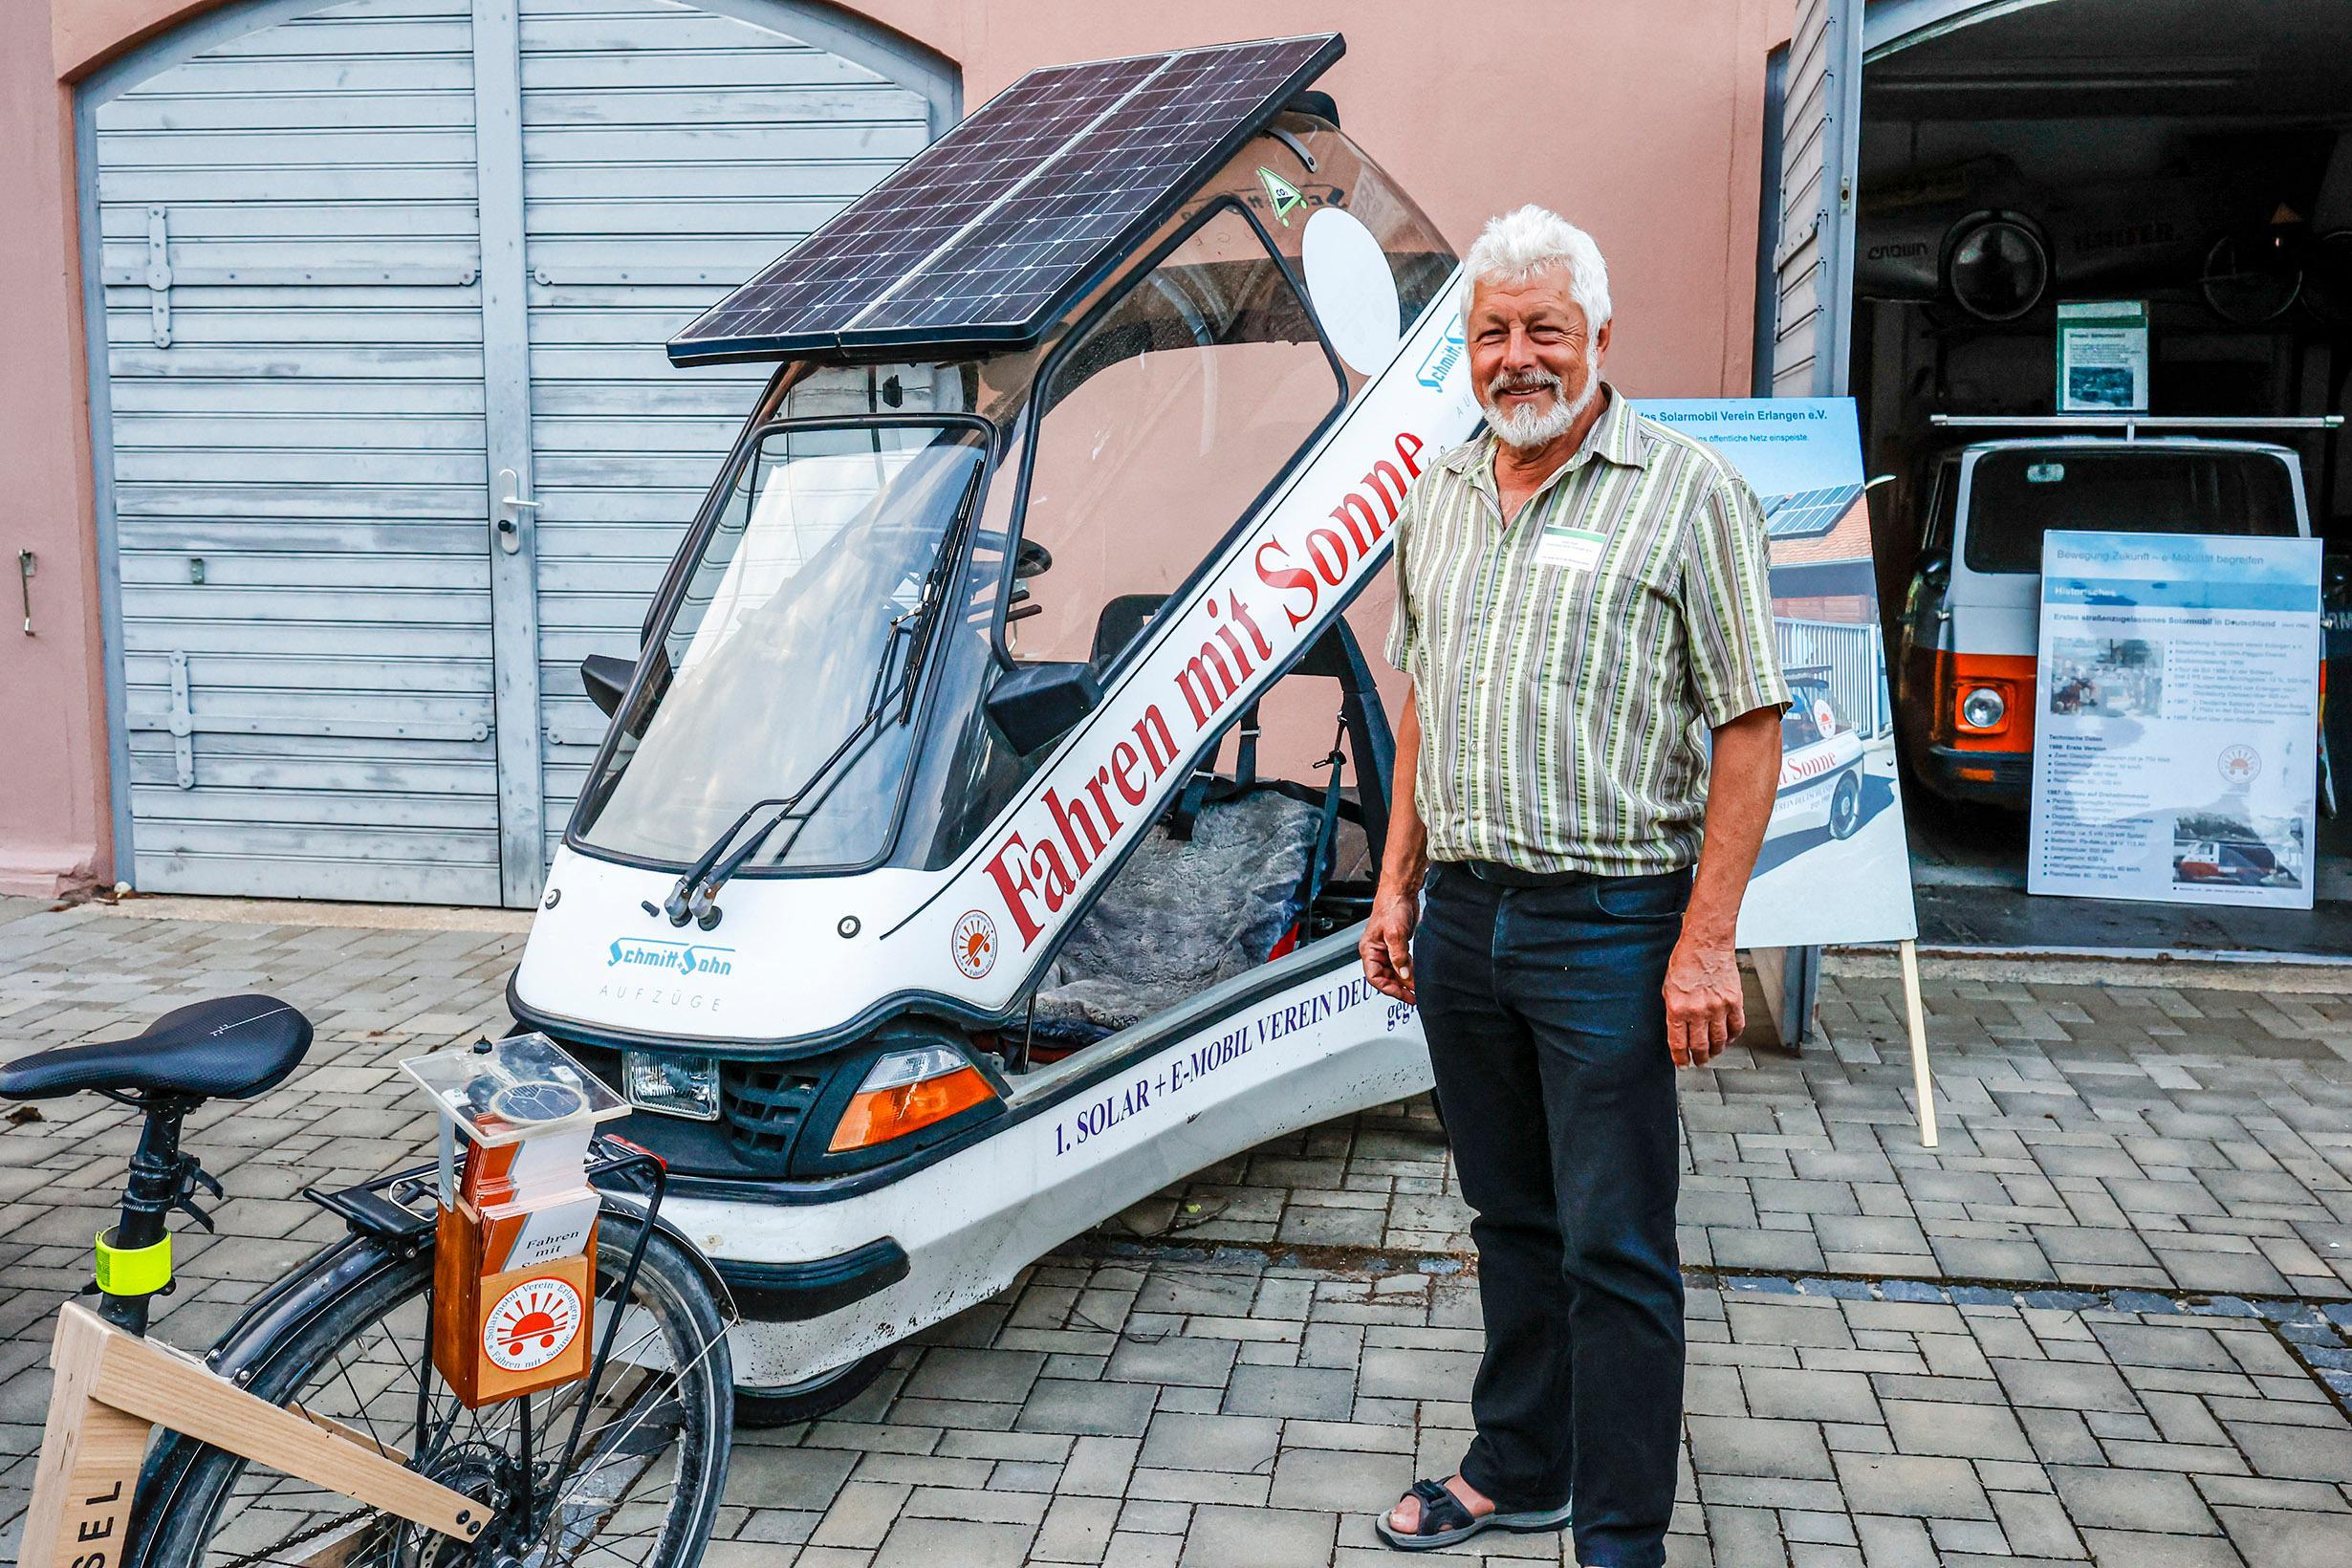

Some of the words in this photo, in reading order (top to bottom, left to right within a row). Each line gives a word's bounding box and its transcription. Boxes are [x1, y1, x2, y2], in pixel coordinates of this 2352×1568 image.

[1660, 411, 1718, 422] Solarmobil
[1720, 410, 1754, 421] Verein
[1757, 410, 1805, 422] Erlangen
[1808, 409, 1827, 420] e.V.
[1710, 434, 1748, 443] öffentliche
[2058, 550, 2109, 562] Bewegung
[2113, 551, 2150, 561] Zukunft
[2216, 555, 2264, 566] begreifen
[2055, 587, 2116, 597] Historisches
[2054, 613, 2079, 621] Erstes
[2168, 616, 2212, 625] Solarmobil
[2224, 619, 2276, 628] Deutschland
[982, 703, 1181, 953] Fahren
[1173, 586, 1274, 732] mit
[1254, 431, 1424, 632] Sonne
[1787, 751, 1837, 780] Sonne
[599, 985, 722, 1013] AUFZÜGE
[1055, 1122, 1071, 1157] 1.
[1077, 1078, 1150, 1144] SOLAR
[1170, 1024, 1253, 1095] E-MOBIL
[1257, 991, 1334, 1049] VEREIN
[1338, 975, 1382, 1013] DEU
[527, 1230, 579, 1250] Fahren
[535, 1245, 561, 1257] mit
[486, 1291, 519, 1340] Solarmobil
[522, 1280, 555, 1293] Verein
[556, 1284, 578, 1320] Erlangen
[491, 1351, 521, 1368] Fahren
[525, 1358, 541, 1369] mit
[546, 1333, 571, 1360] Sonne
